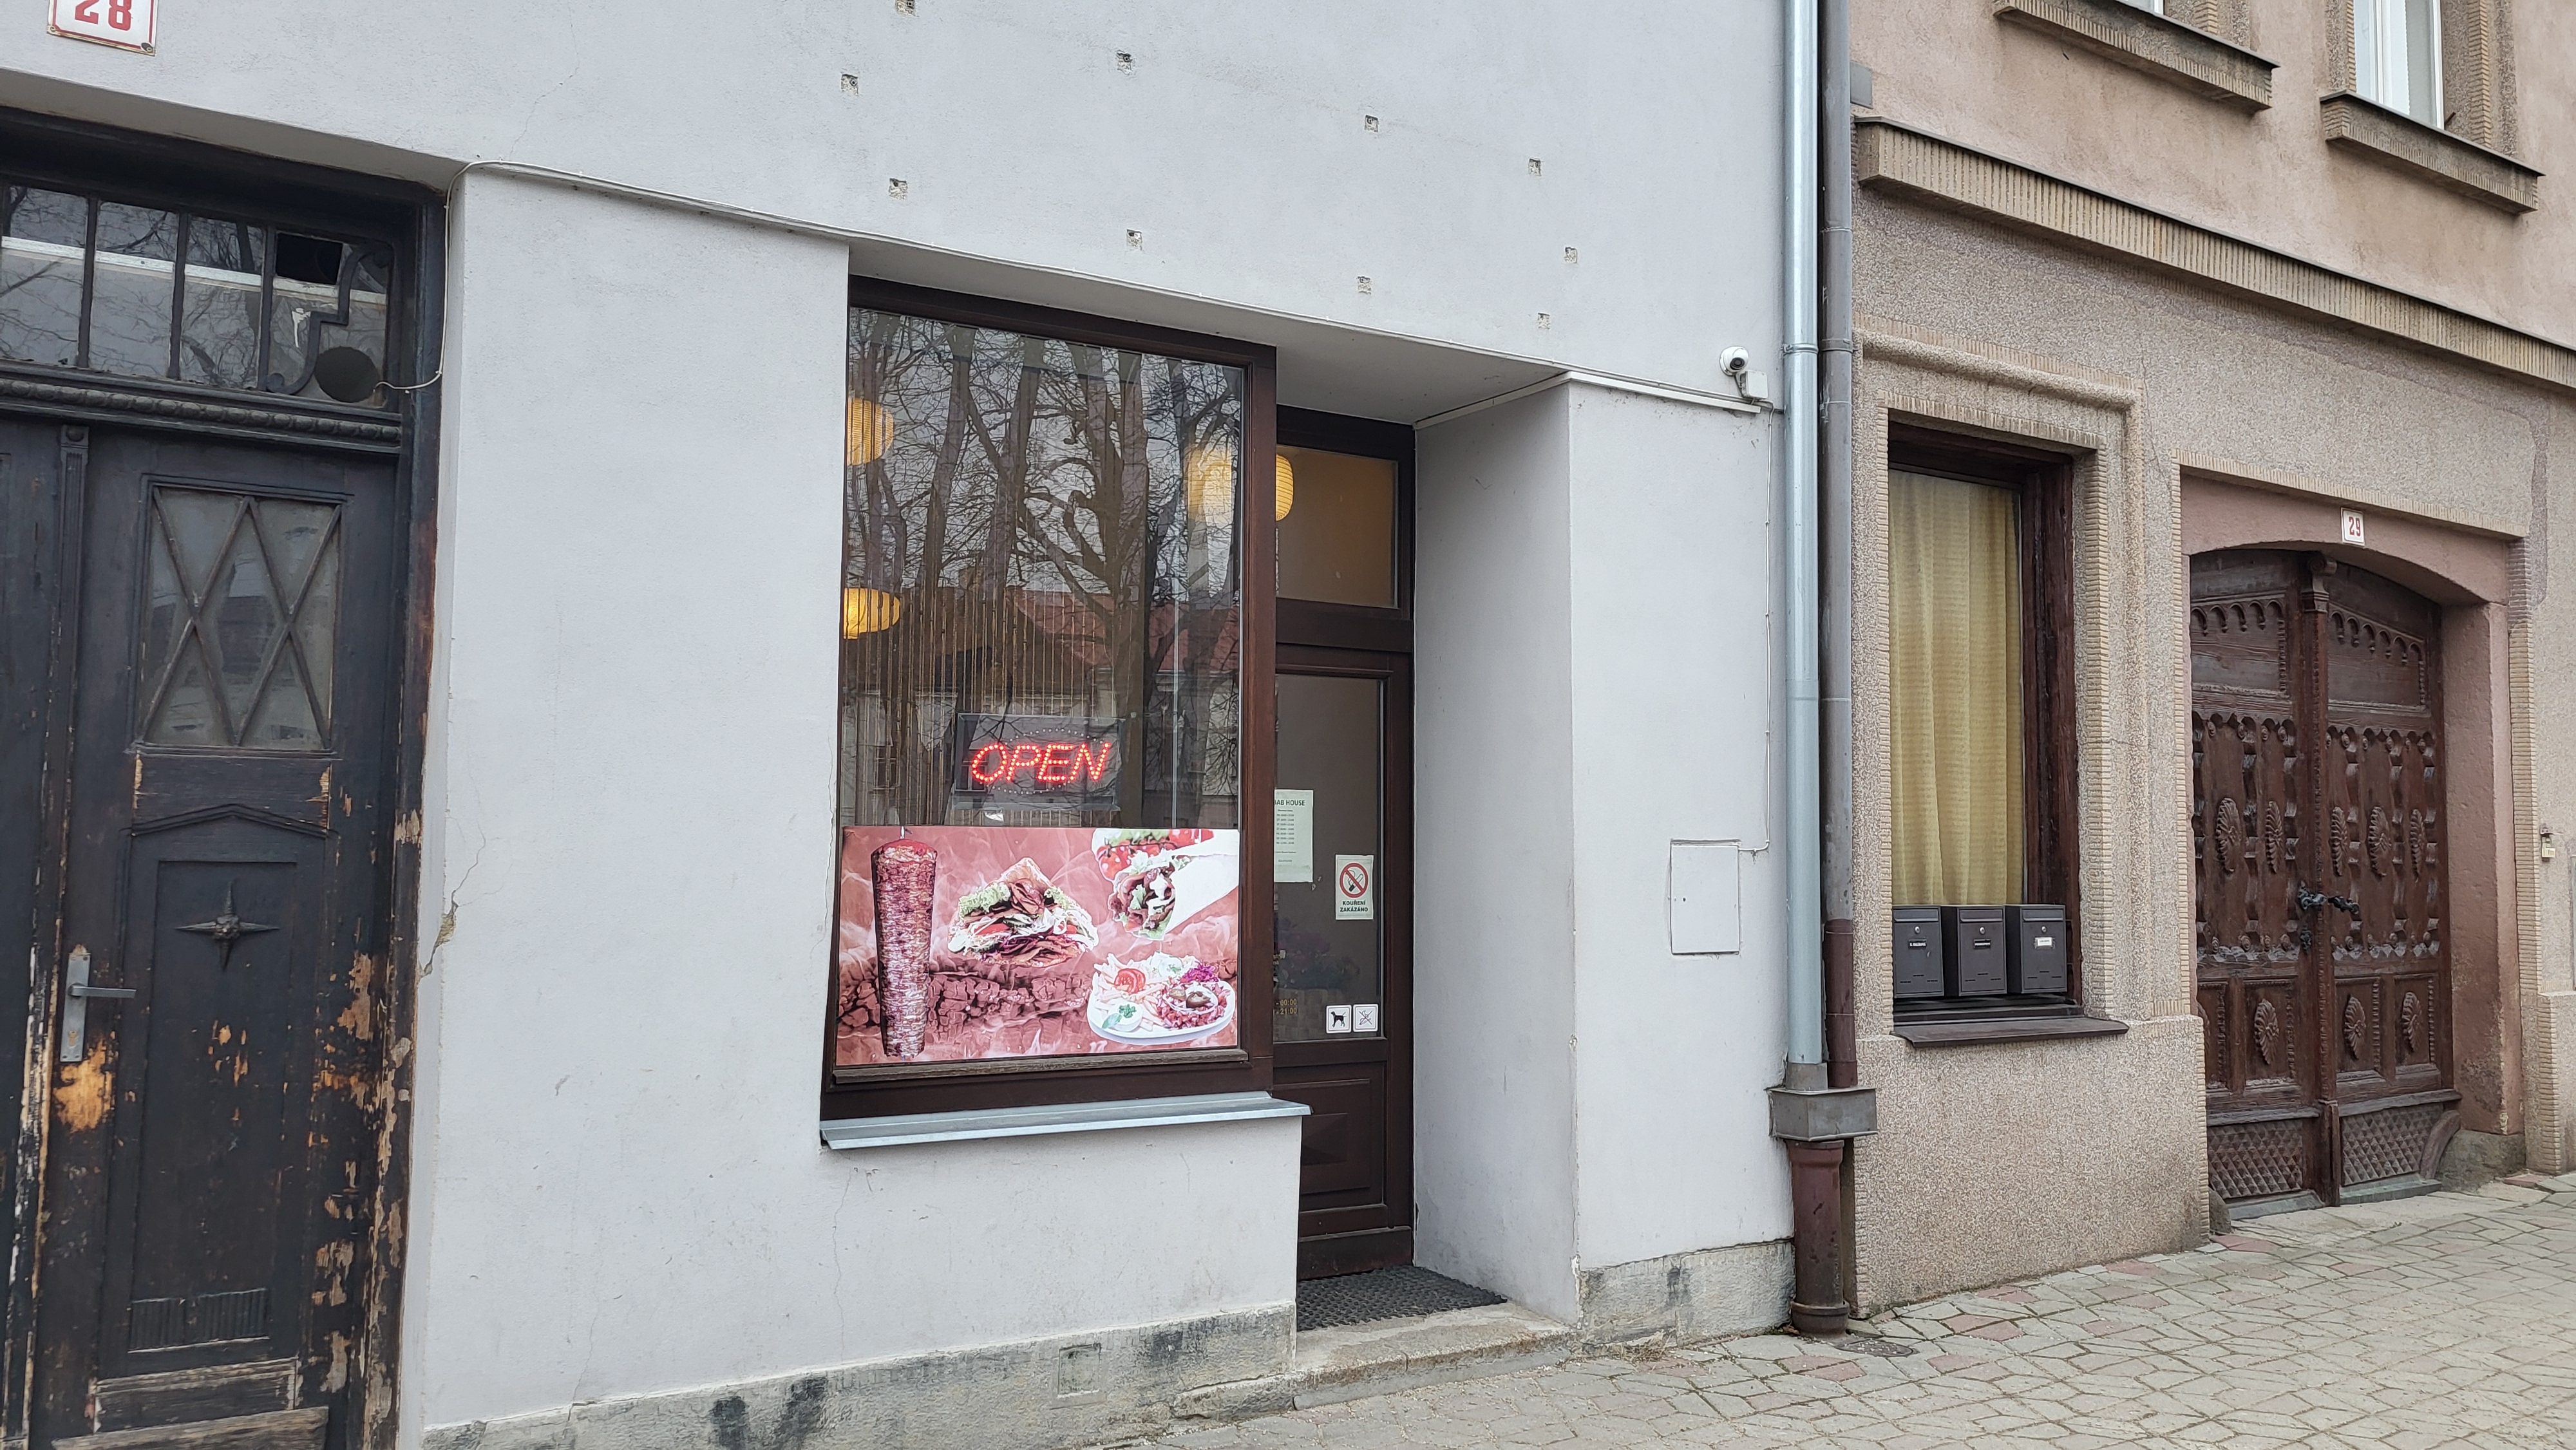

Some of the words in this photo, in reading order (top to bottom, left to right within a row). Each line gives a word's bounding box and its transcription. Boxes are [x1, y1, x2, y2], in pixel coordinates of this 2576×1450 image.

[75, 0, 132, 31] 28
[2348, 516, 2361, 536] 29
[972, 742, 1112, 783] OPEN
